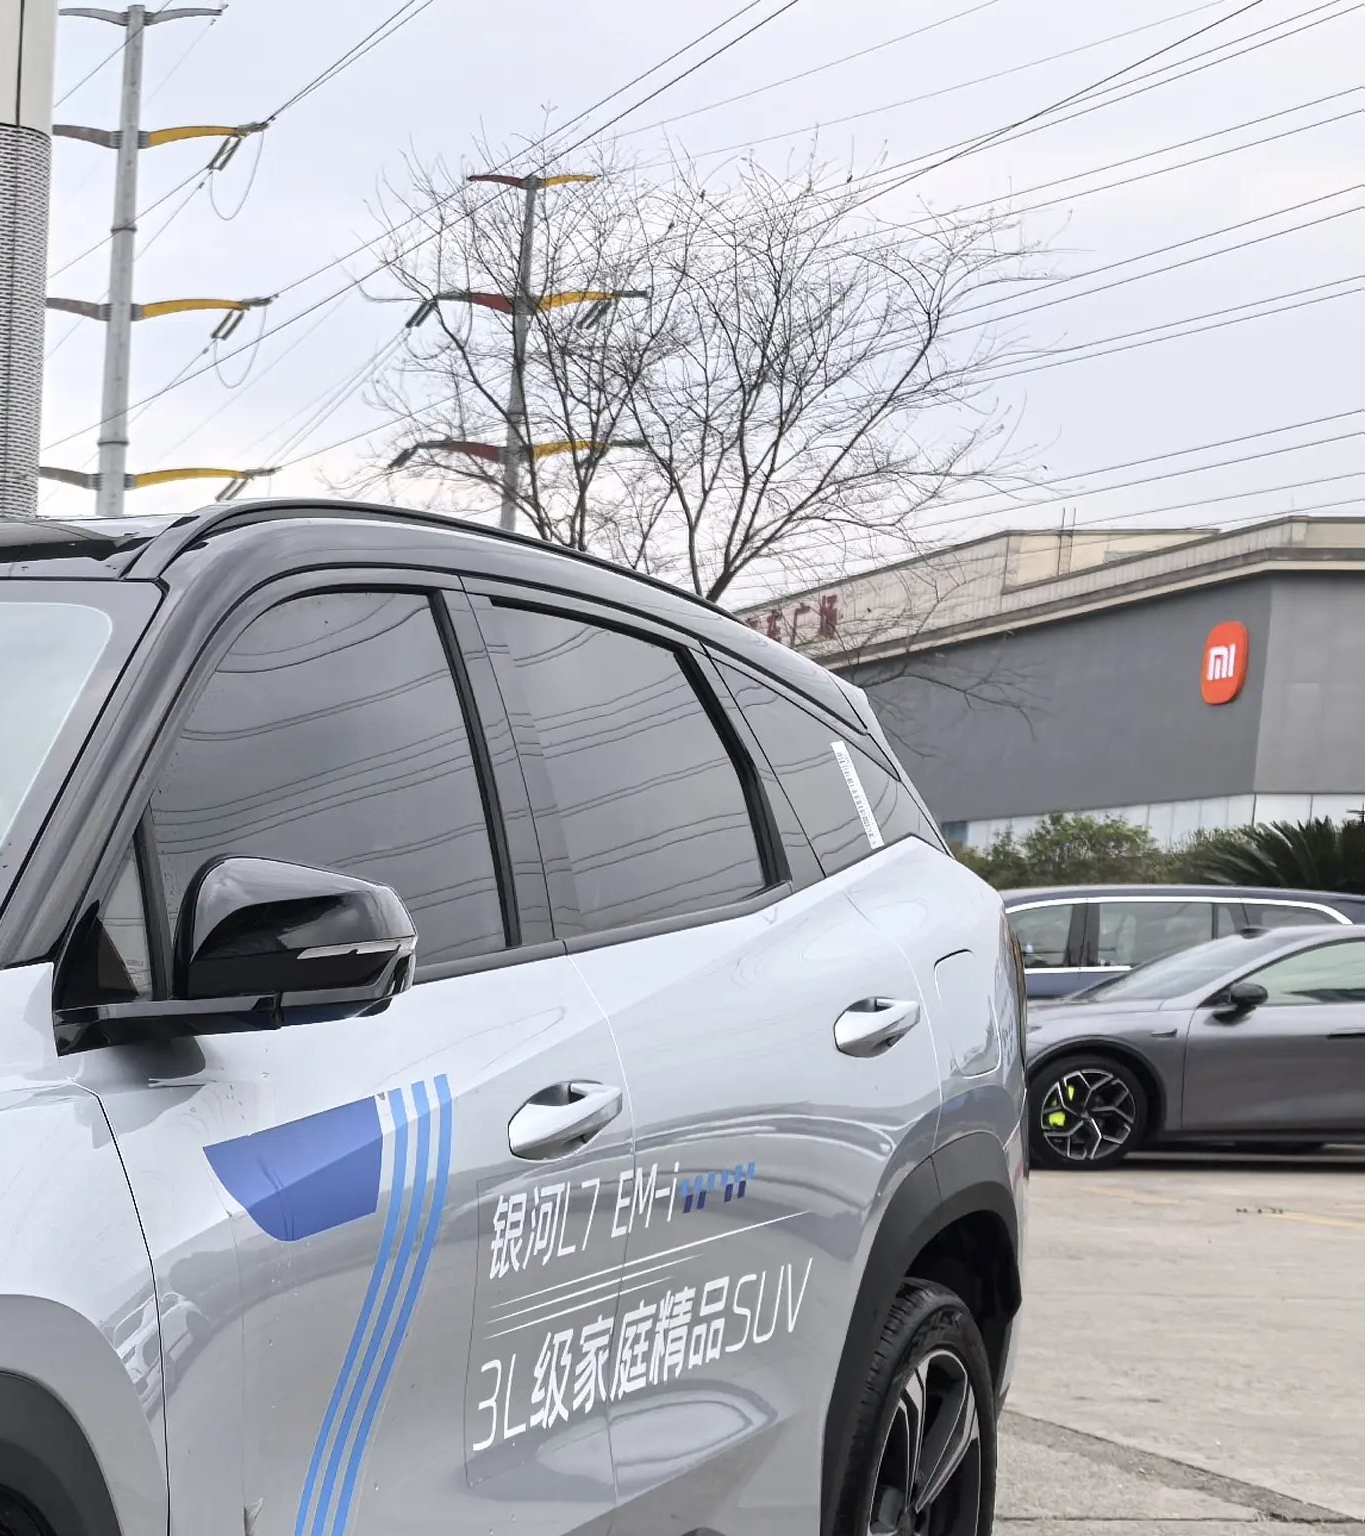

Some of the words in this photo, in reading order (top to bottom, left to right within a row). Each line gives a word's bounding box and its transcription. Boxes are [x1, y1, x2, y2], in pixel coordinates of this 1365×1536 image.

[489, 1177, 600, 1280] 银河L7
[611, 1161, 680, 1238] EM-i
[473, 1257, 813, 1451] 3L级家庭精品SUV
